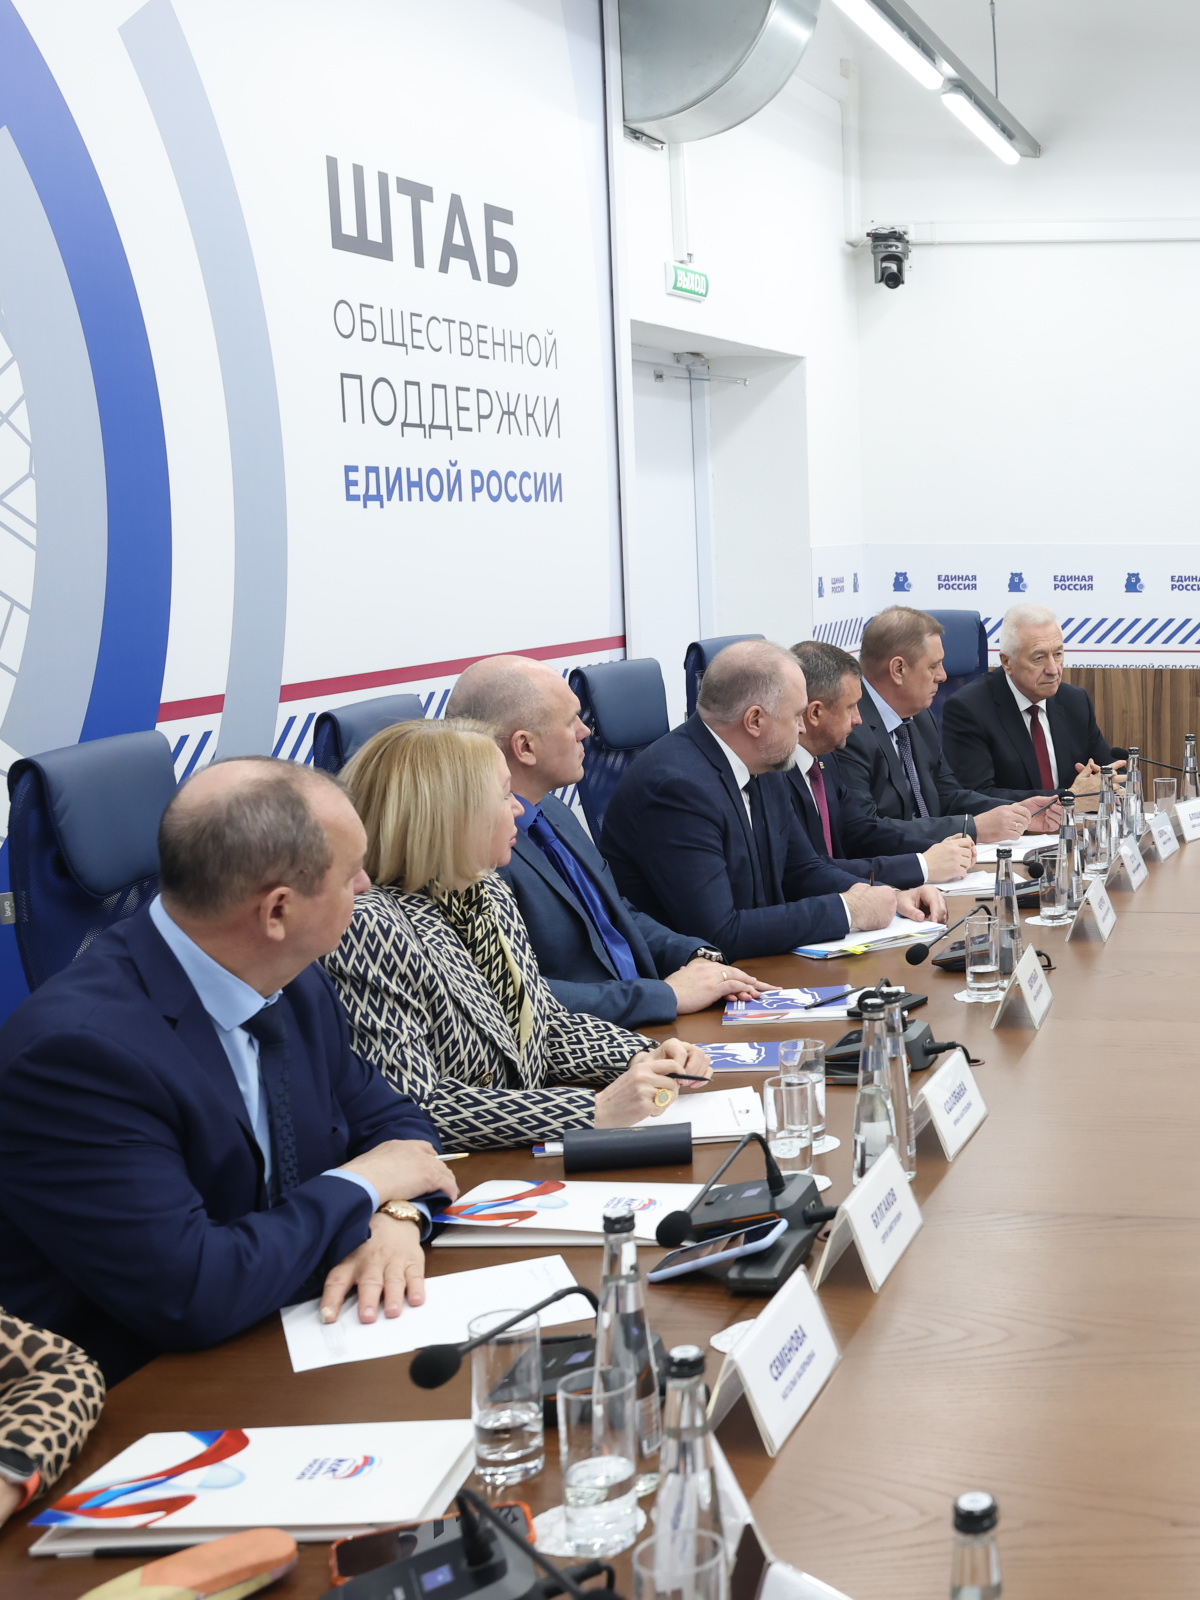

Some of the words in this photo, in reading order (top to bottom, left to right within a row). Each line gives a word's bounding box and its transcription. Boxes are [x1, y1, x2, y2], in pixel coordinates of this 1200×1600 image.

[326, 154, 519, 288] ШТАБ
[676, 269, 707, 295] ВЫХОД
[333, 299, 558, 370] ОБЩЕСТВЕННОЙ
[340, 372, 561, 441] ПОДДЕРЖКИ
[344, 460, 463, 509] ЕДИНОЙ
[470, 469, 563, 503] РОССИИ
[937, 575, 977, 583] ЕДИНАЯ
[937, 583, 977, 591] РОССИЯ
[1053, 575, 1093, 583] ЕДИНАЯ
[1053, 583, 1093, 591] РОССИЯ
[769, 1323, 807, 1382] СЕМЕНОВА
